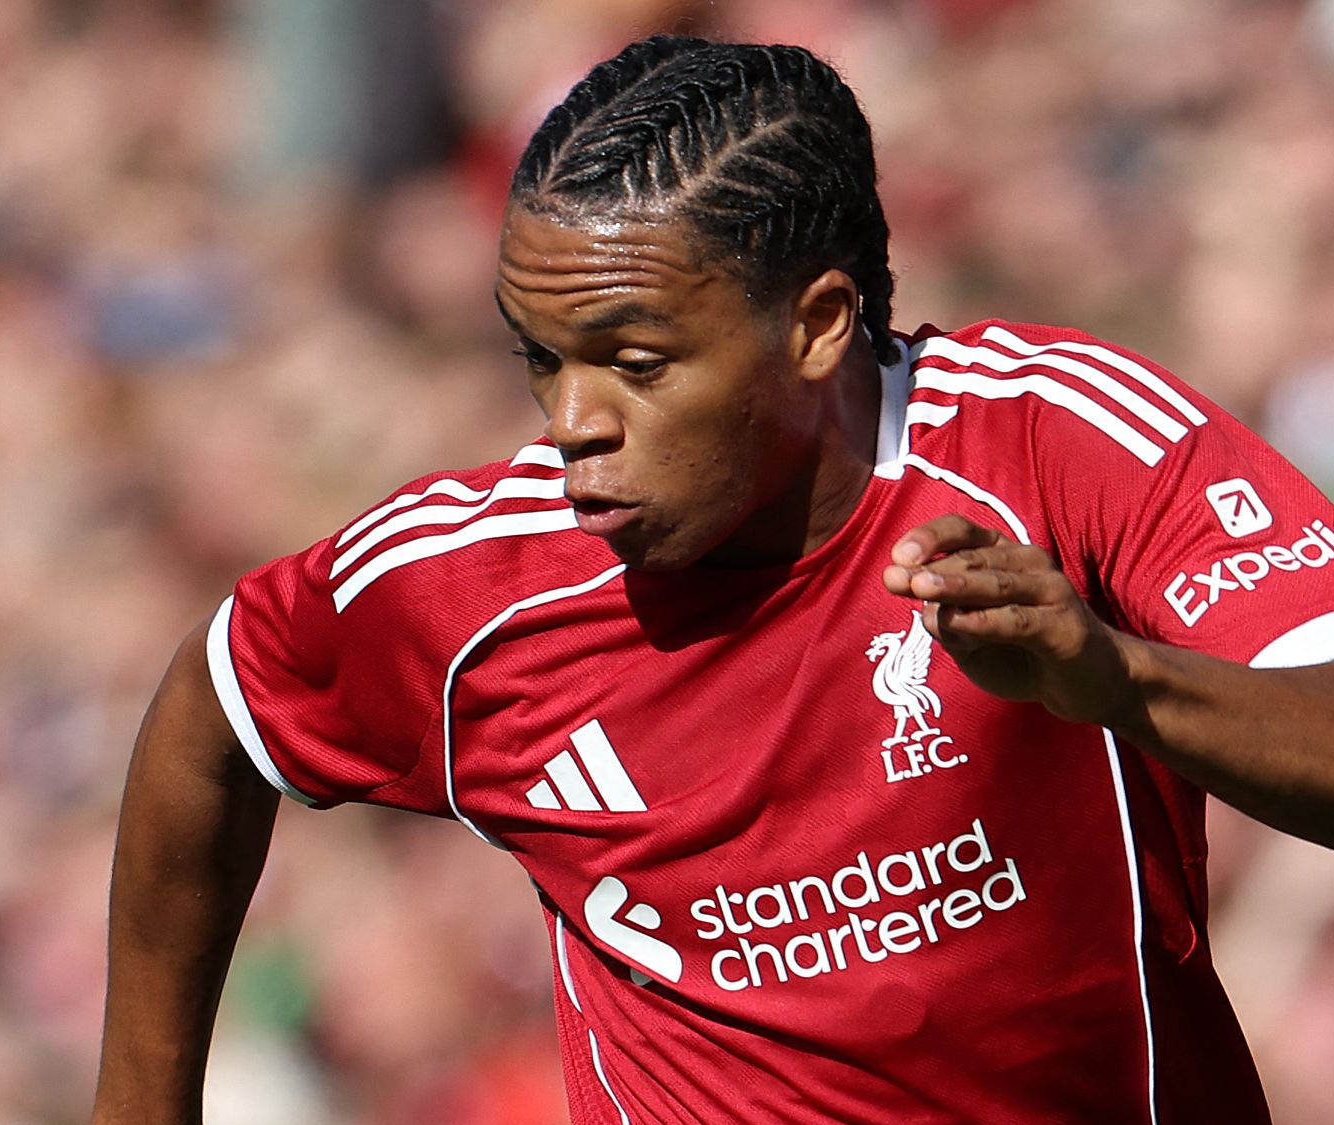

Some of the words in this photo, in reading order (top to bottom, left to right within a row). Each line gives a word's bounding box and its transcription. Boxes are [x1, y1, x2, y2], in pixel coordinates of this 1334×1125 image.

[880, 736, 969, 783] L.F.C.
[689, 818, 994, 940] standard
[710, 857, 1027, 991] chartered
